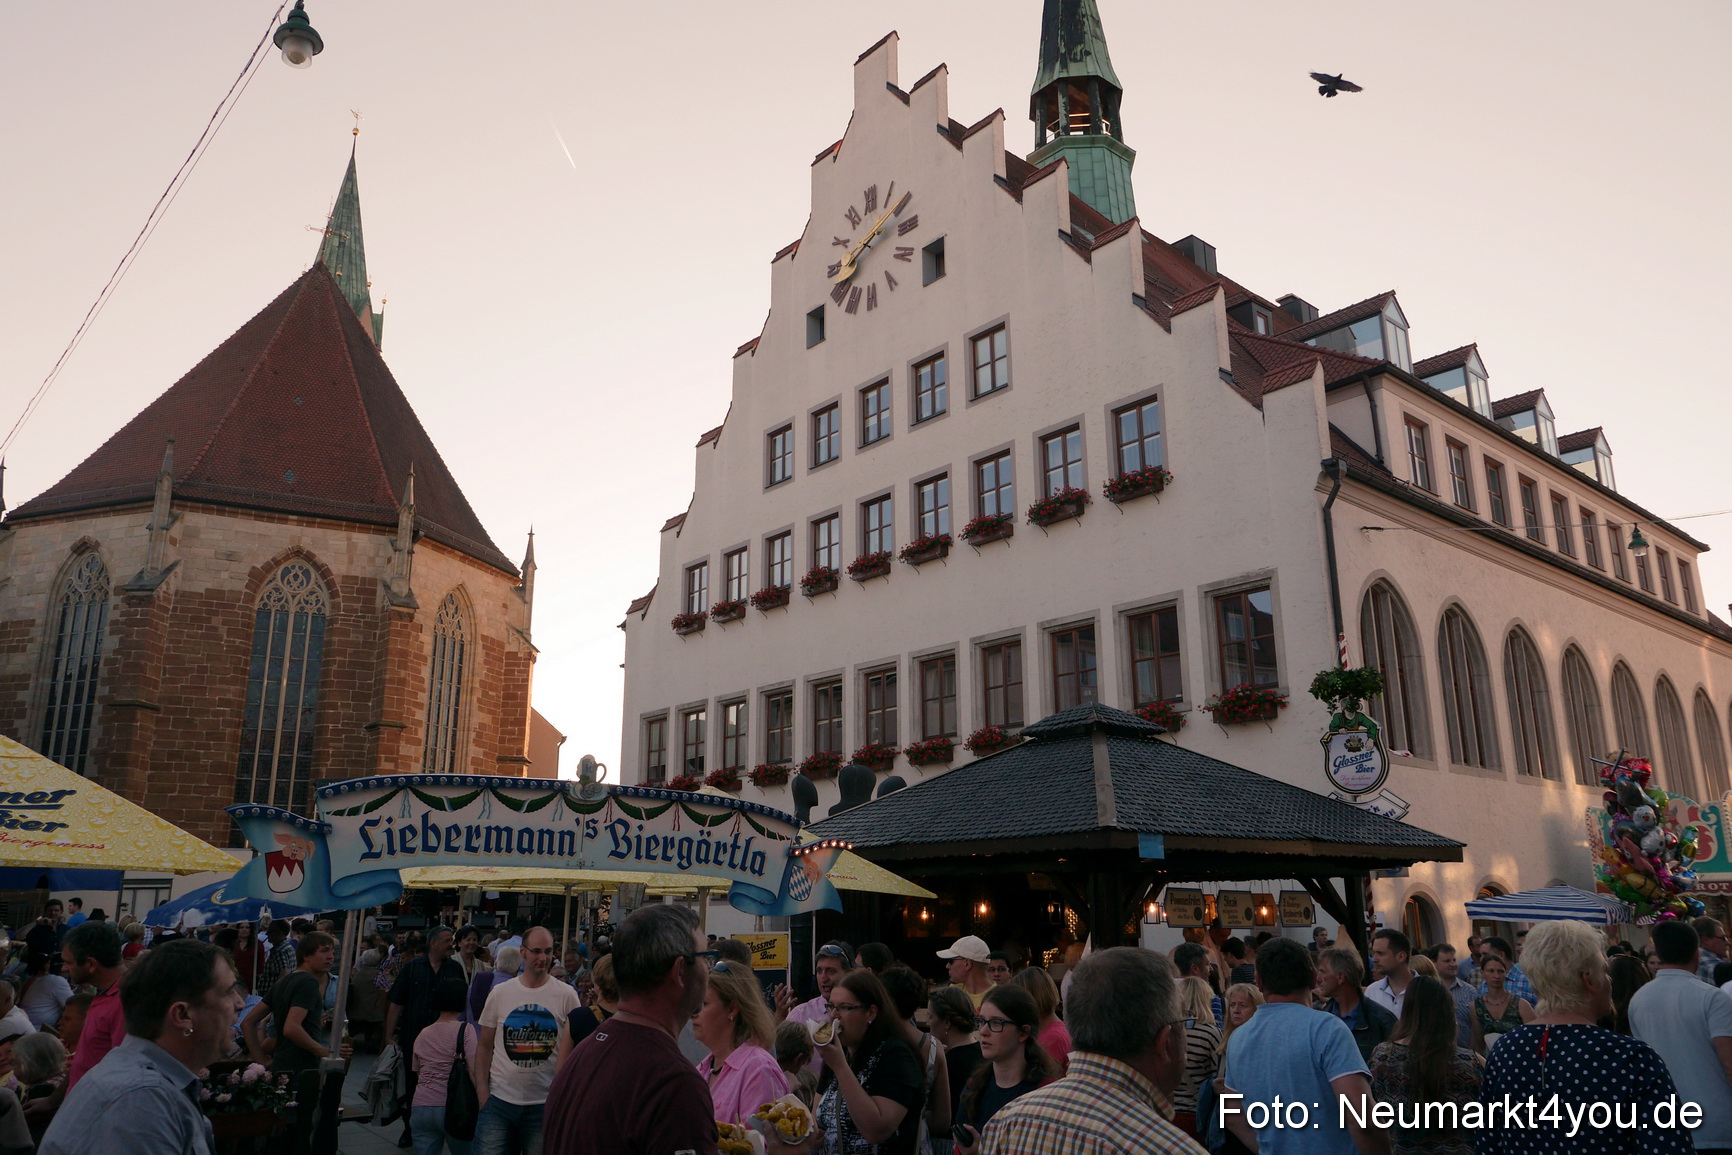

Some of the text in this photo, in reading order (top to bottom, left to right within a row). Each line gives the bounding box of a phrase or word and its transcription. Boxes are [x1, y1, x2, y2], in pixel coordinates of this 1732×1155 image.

[1333, 750, 1375, 775] Glossner
[1355, 763, 1376, 774] Bier
[358, 810, 767, 877] Liebermann's Biergärtla
[760, 951, 776, 960] Bier
[506, 1027, 556, 1040] California
